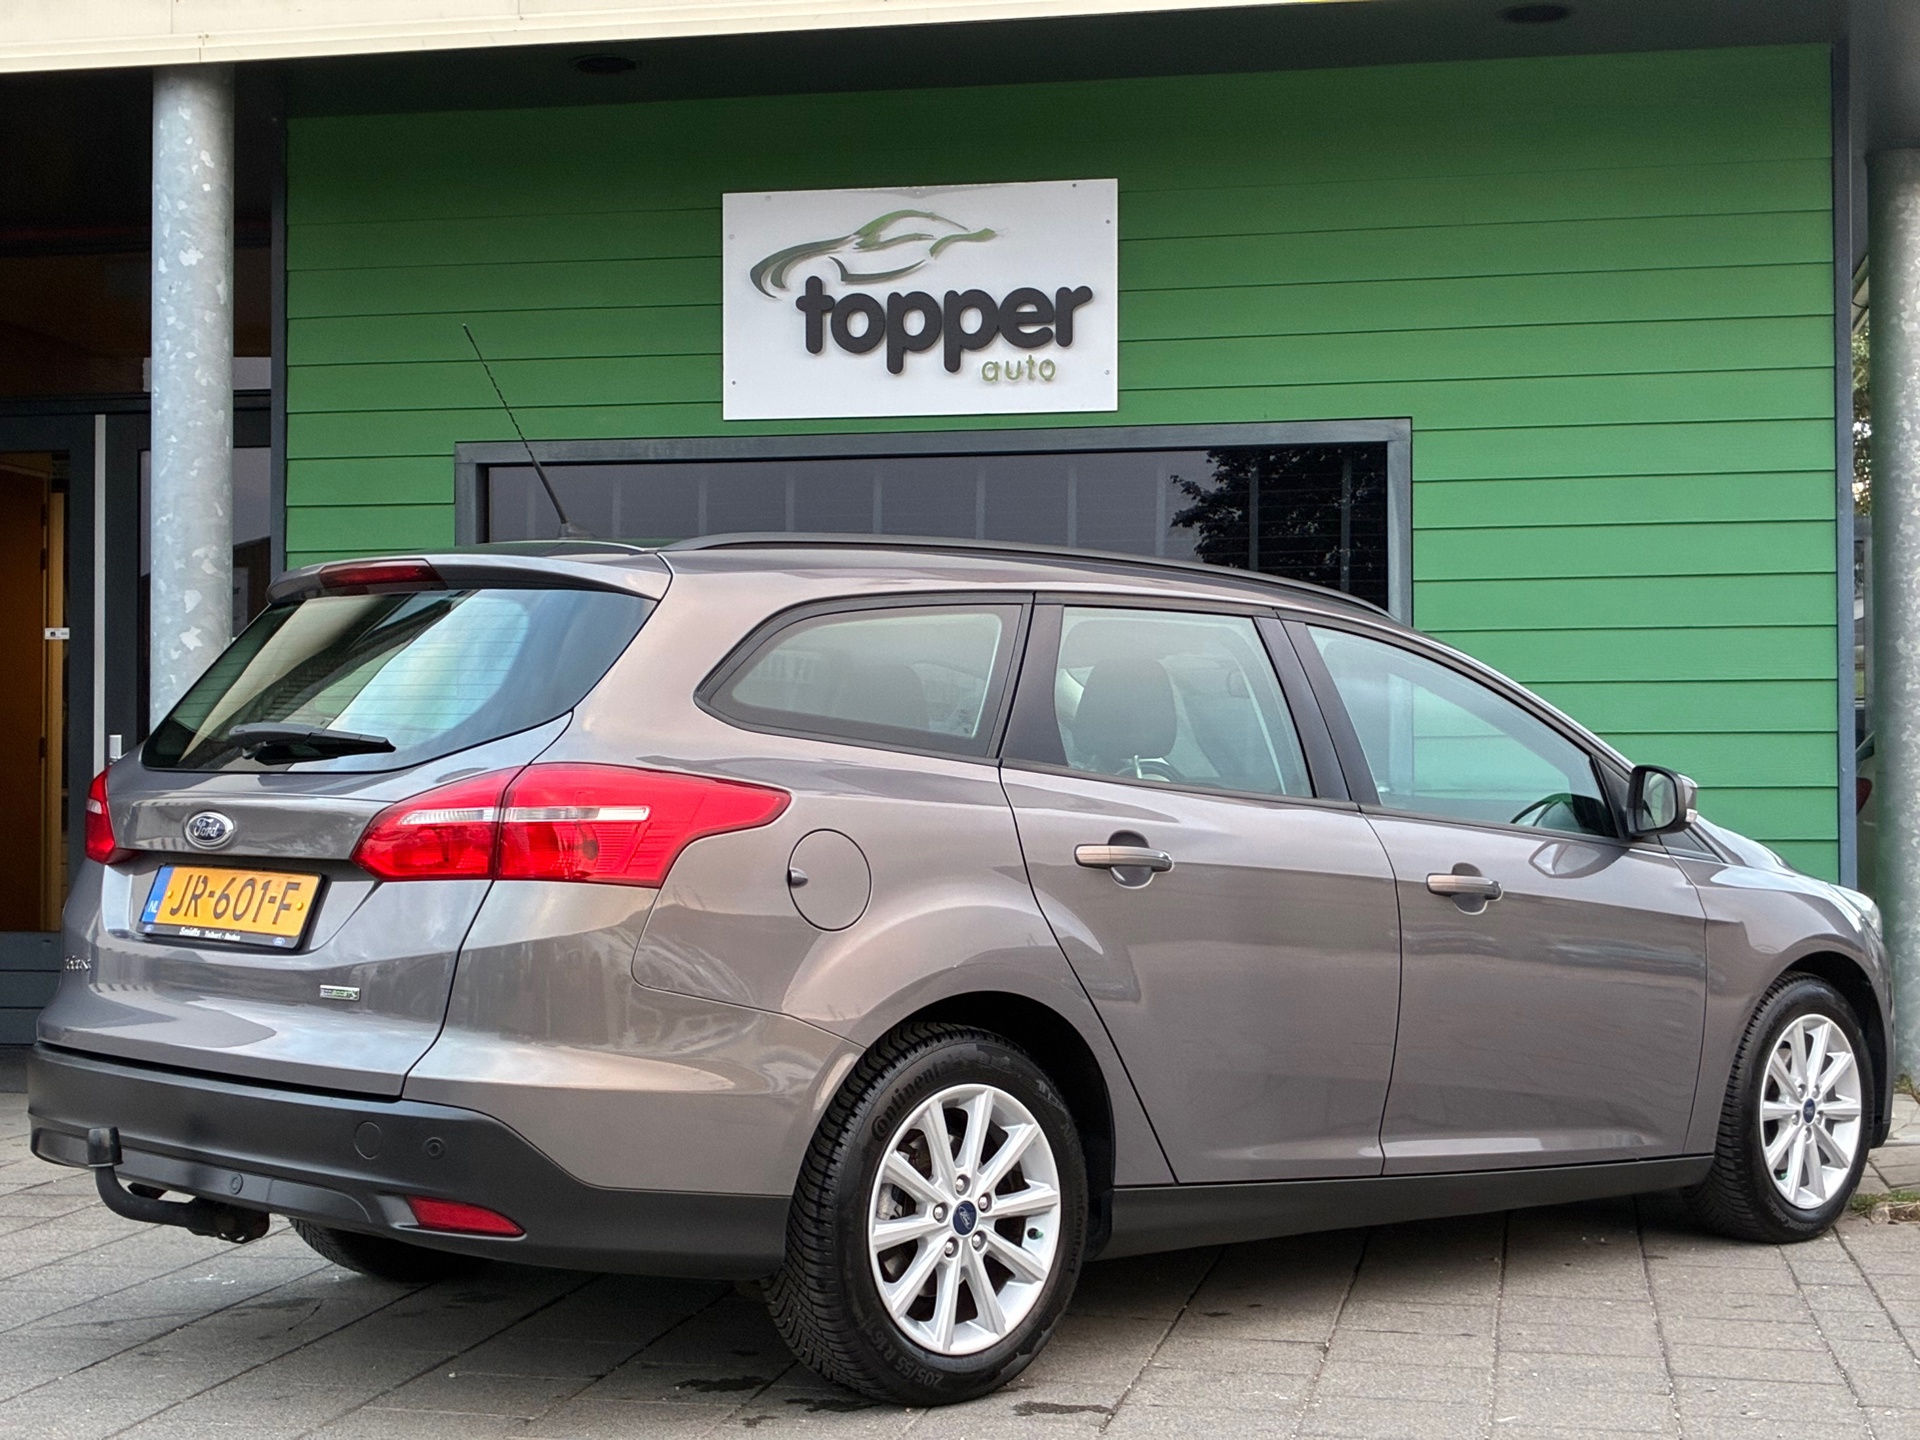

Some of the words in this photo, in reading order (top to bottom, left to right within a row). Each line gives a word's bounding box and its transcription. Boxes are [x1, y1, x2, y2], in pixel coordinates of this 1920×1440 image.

[796, 275, 1094, 375] topper
[981, 354, 1057, 383] auto
[193, 817, 220, 837] Ford
[147, 900, 159, 913] NL
[168, 873, 302, 925] JR-601-F
